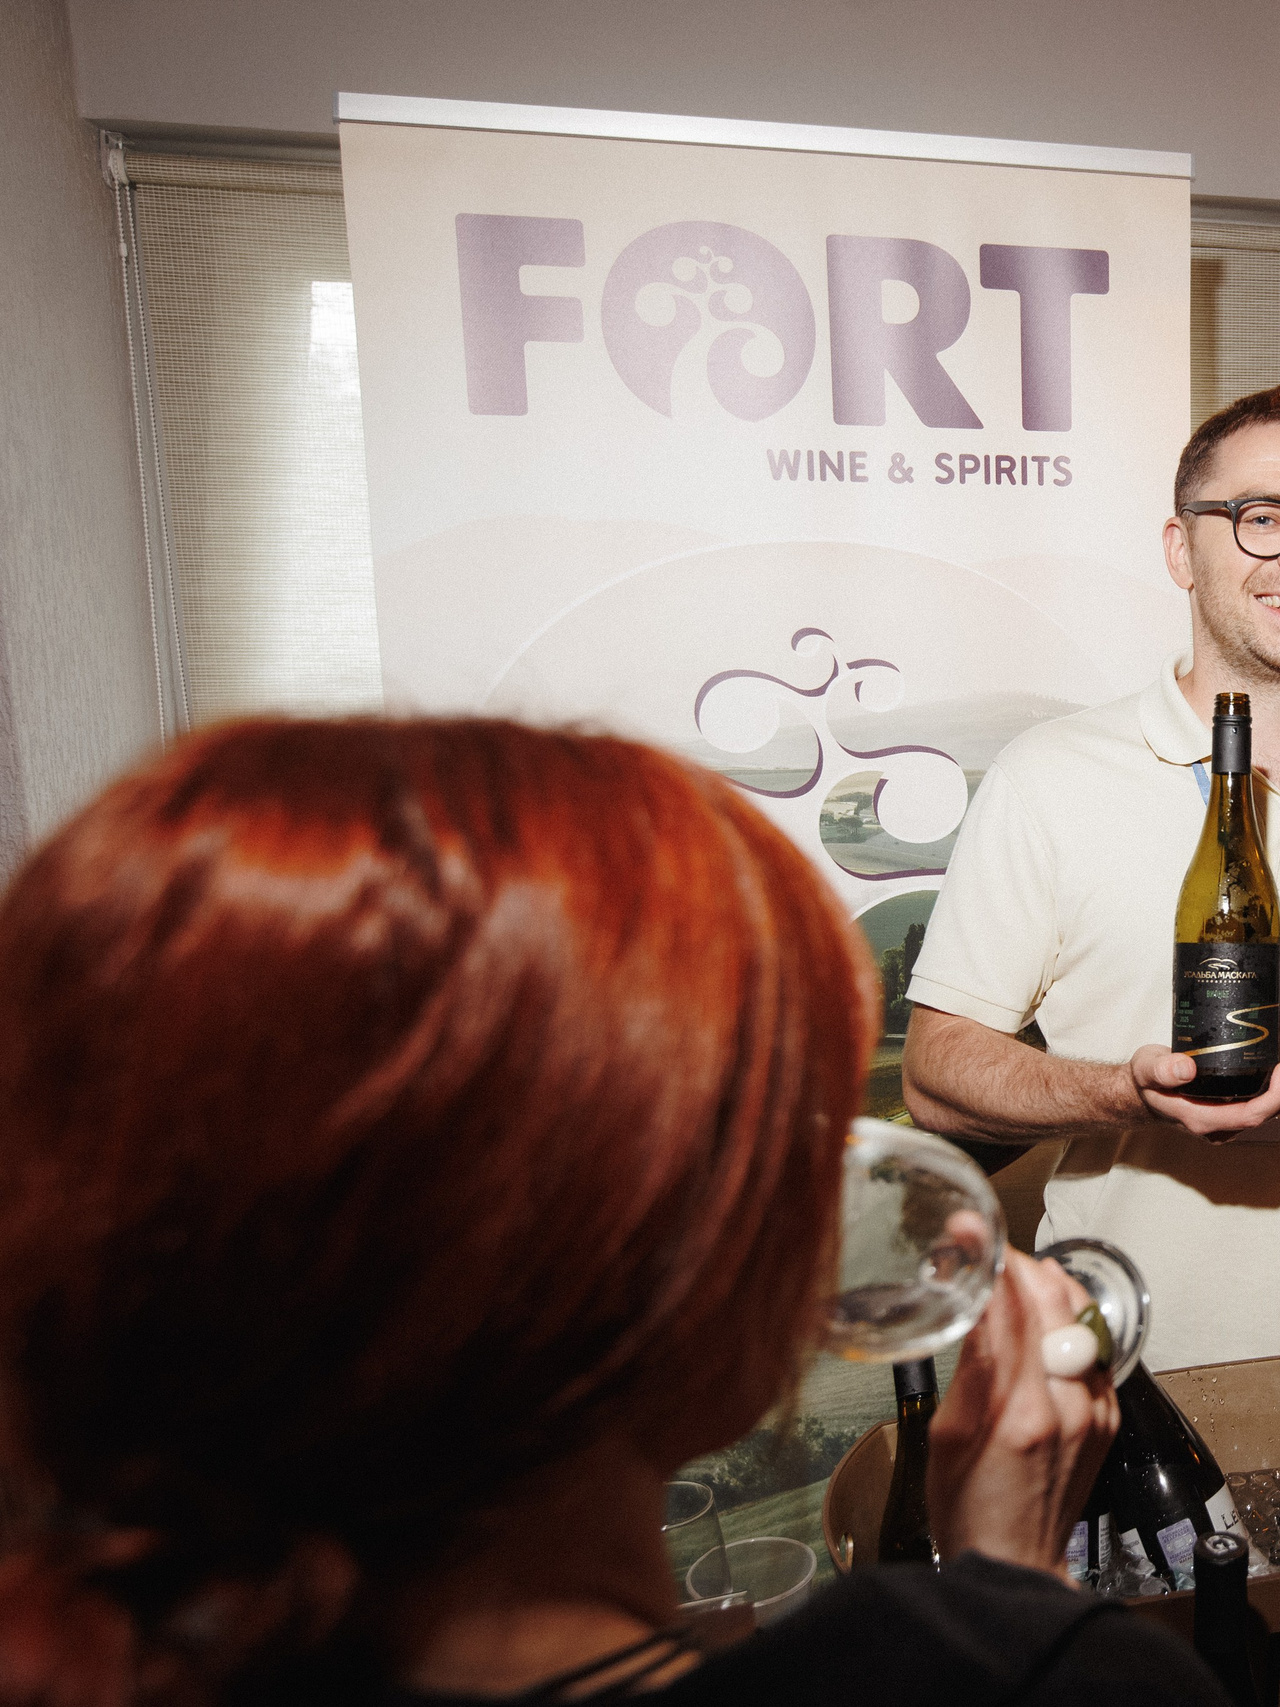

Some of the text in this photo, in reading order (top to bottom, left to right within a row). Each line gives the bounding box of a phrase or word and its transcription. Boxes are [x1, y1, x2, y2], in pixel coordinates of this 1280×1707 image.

[455, 212, 1110, 432] FORT
[766, 448, 1073, 487] WINE & SPIRITS
[1184, 970, 1257, 979] УСАДЬБА МАСКАГА
